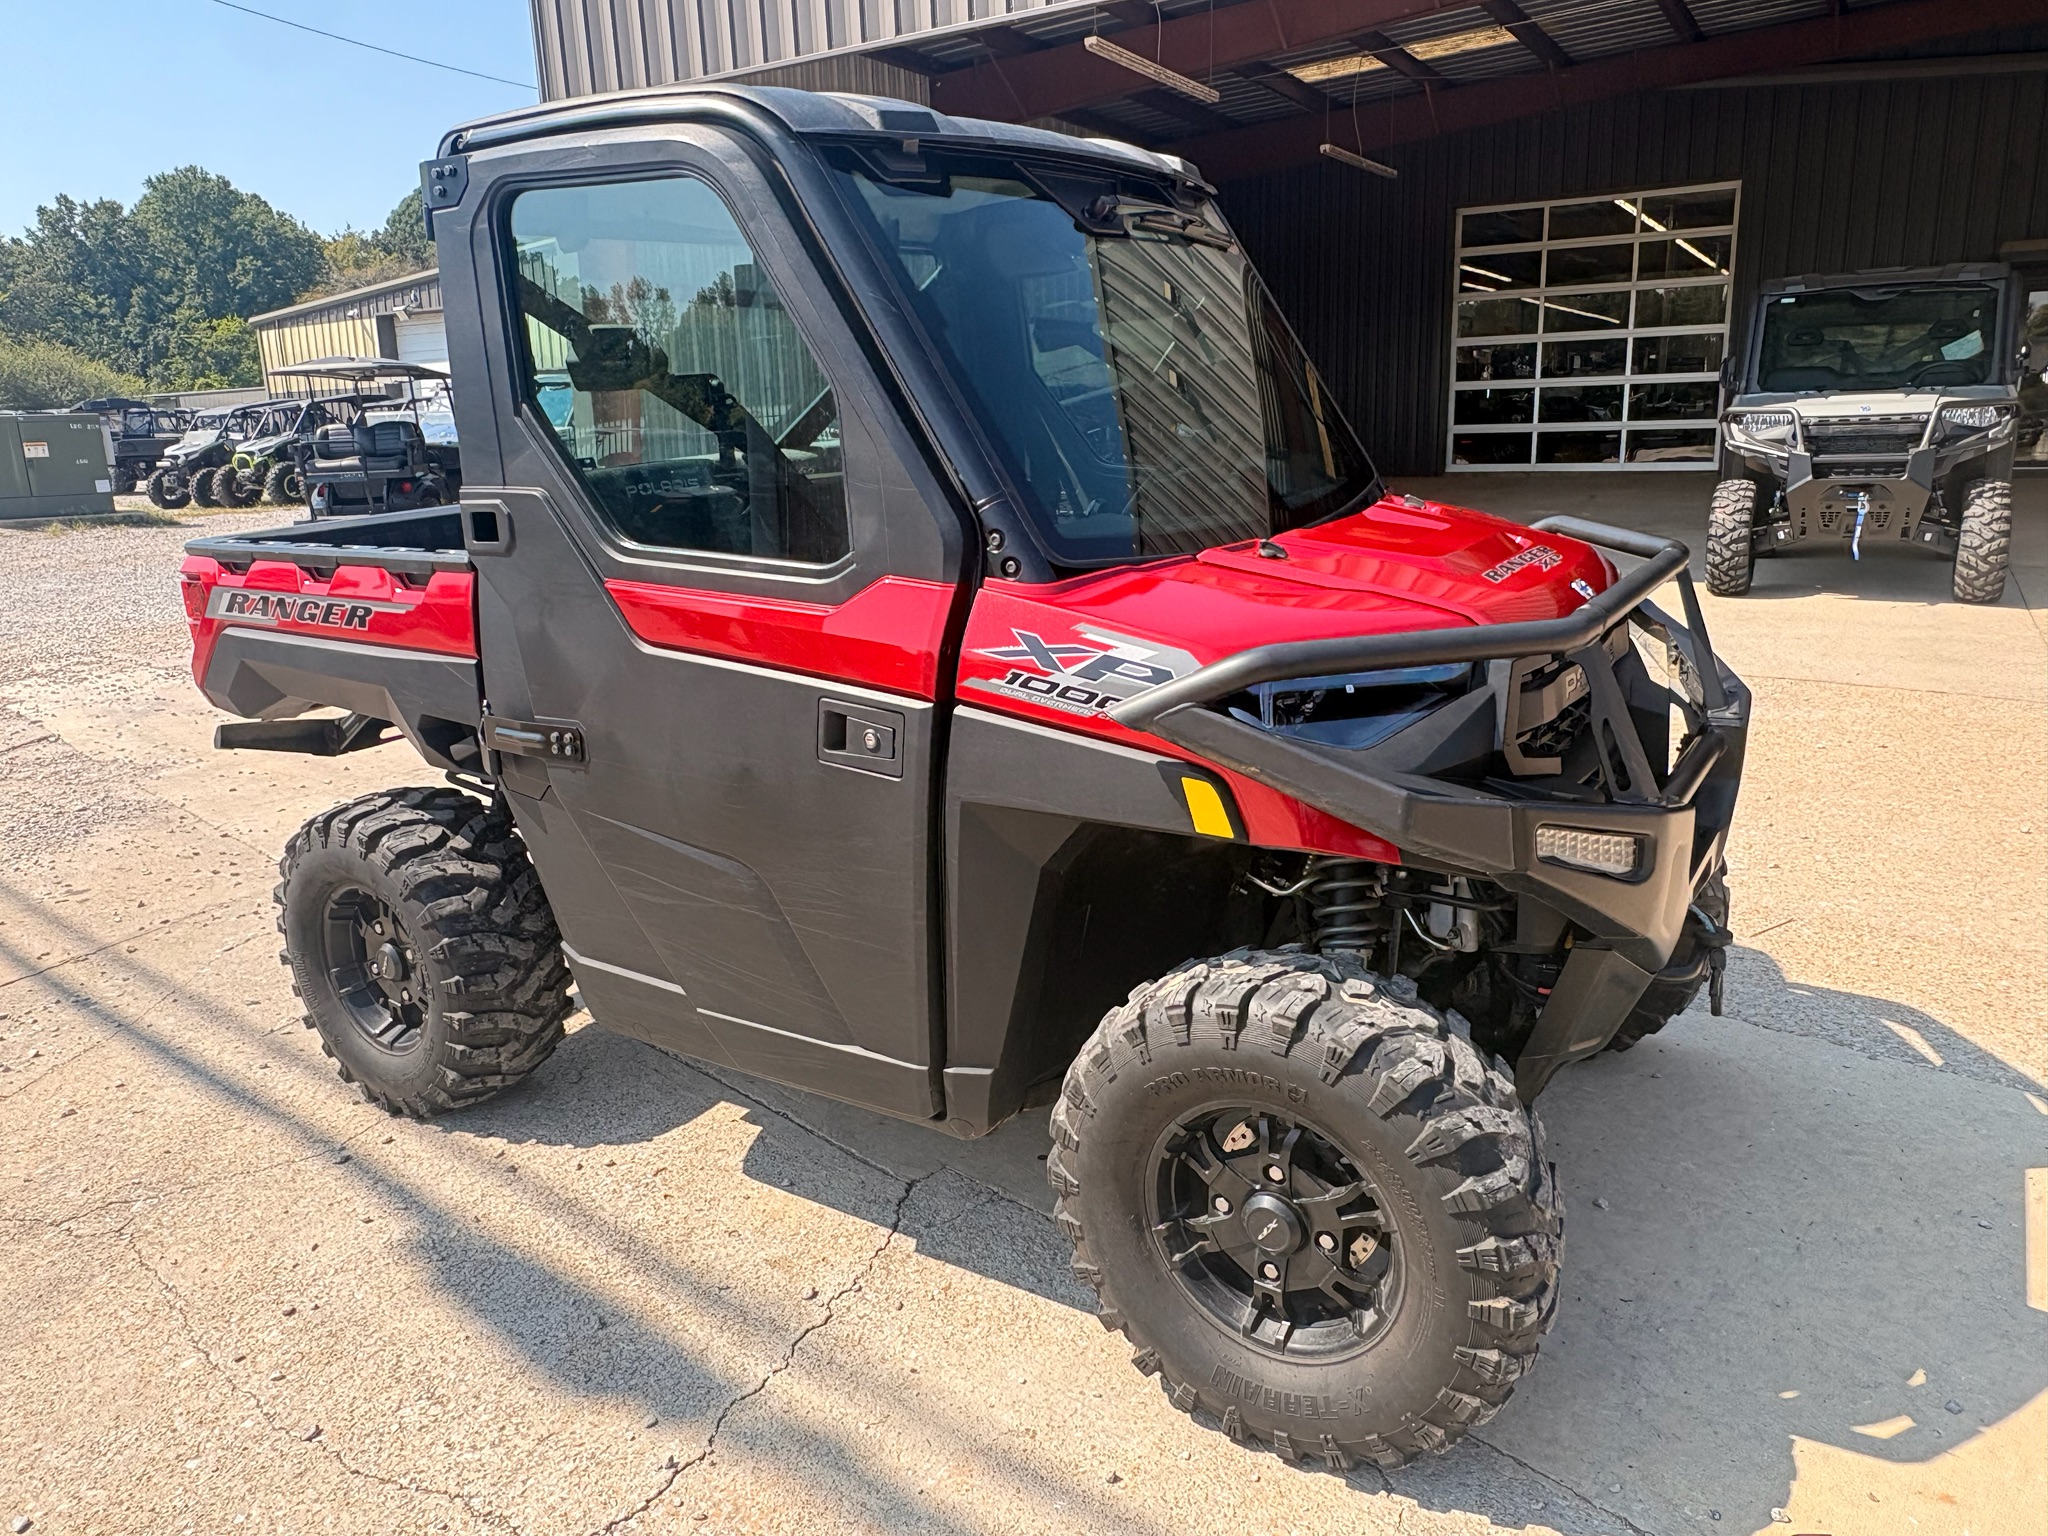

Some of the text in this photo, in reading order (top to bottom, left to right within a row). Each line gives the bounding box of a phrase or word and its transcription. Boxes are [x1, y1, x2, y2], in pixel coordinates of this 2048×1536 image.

[624, 478, 700, 498] POLARIS
[1482, 545, 1556, 584] RANGER
[1533, 553, 1563, 572] XP
[224, 591, 375, 631] RANGER
[970, 628, 1176, 685] XP
[999, 687, 1029, 701] DUAL
[1192, 1066, 1281, 1093] ARMOR
[1209, 1364, 1372, 1420] X-TERRAIN
